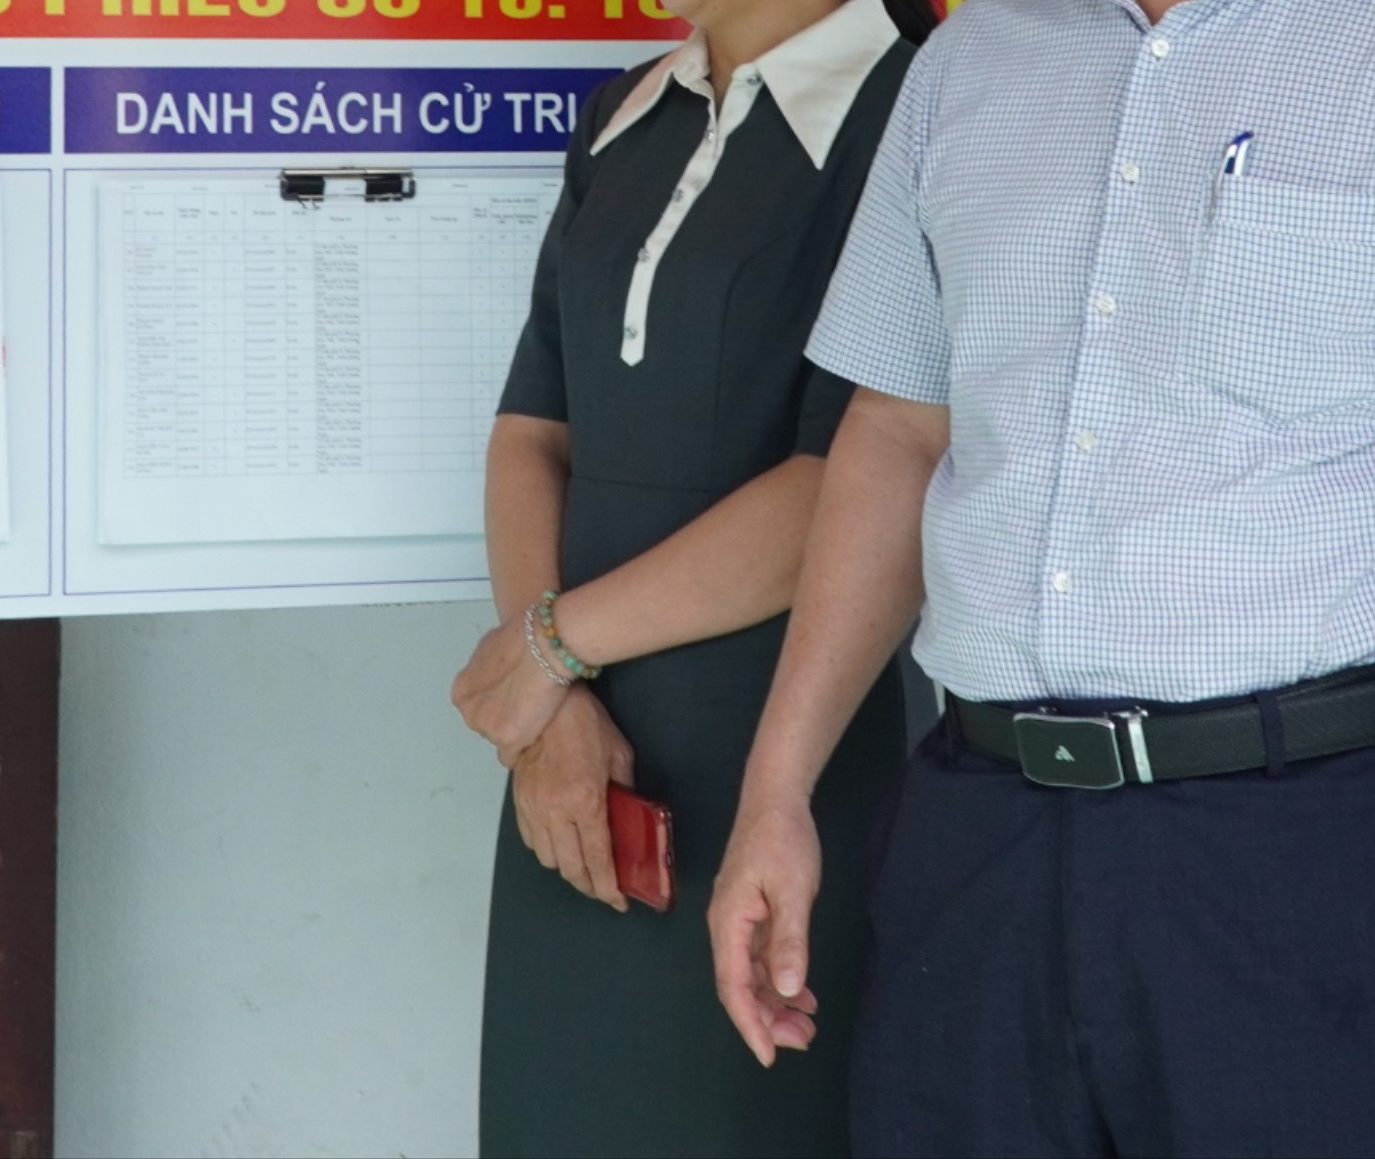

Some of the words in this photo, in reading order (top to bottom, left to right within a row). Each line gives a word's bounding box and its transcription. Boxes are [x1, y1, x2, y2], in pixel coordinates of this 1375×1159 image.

[116, 93, 253, 135] DANH
[270, 81, 402, 135] SÁCH
[418, 83, 492, 134] CỬ
[503, 92, 576, 133] TRI
